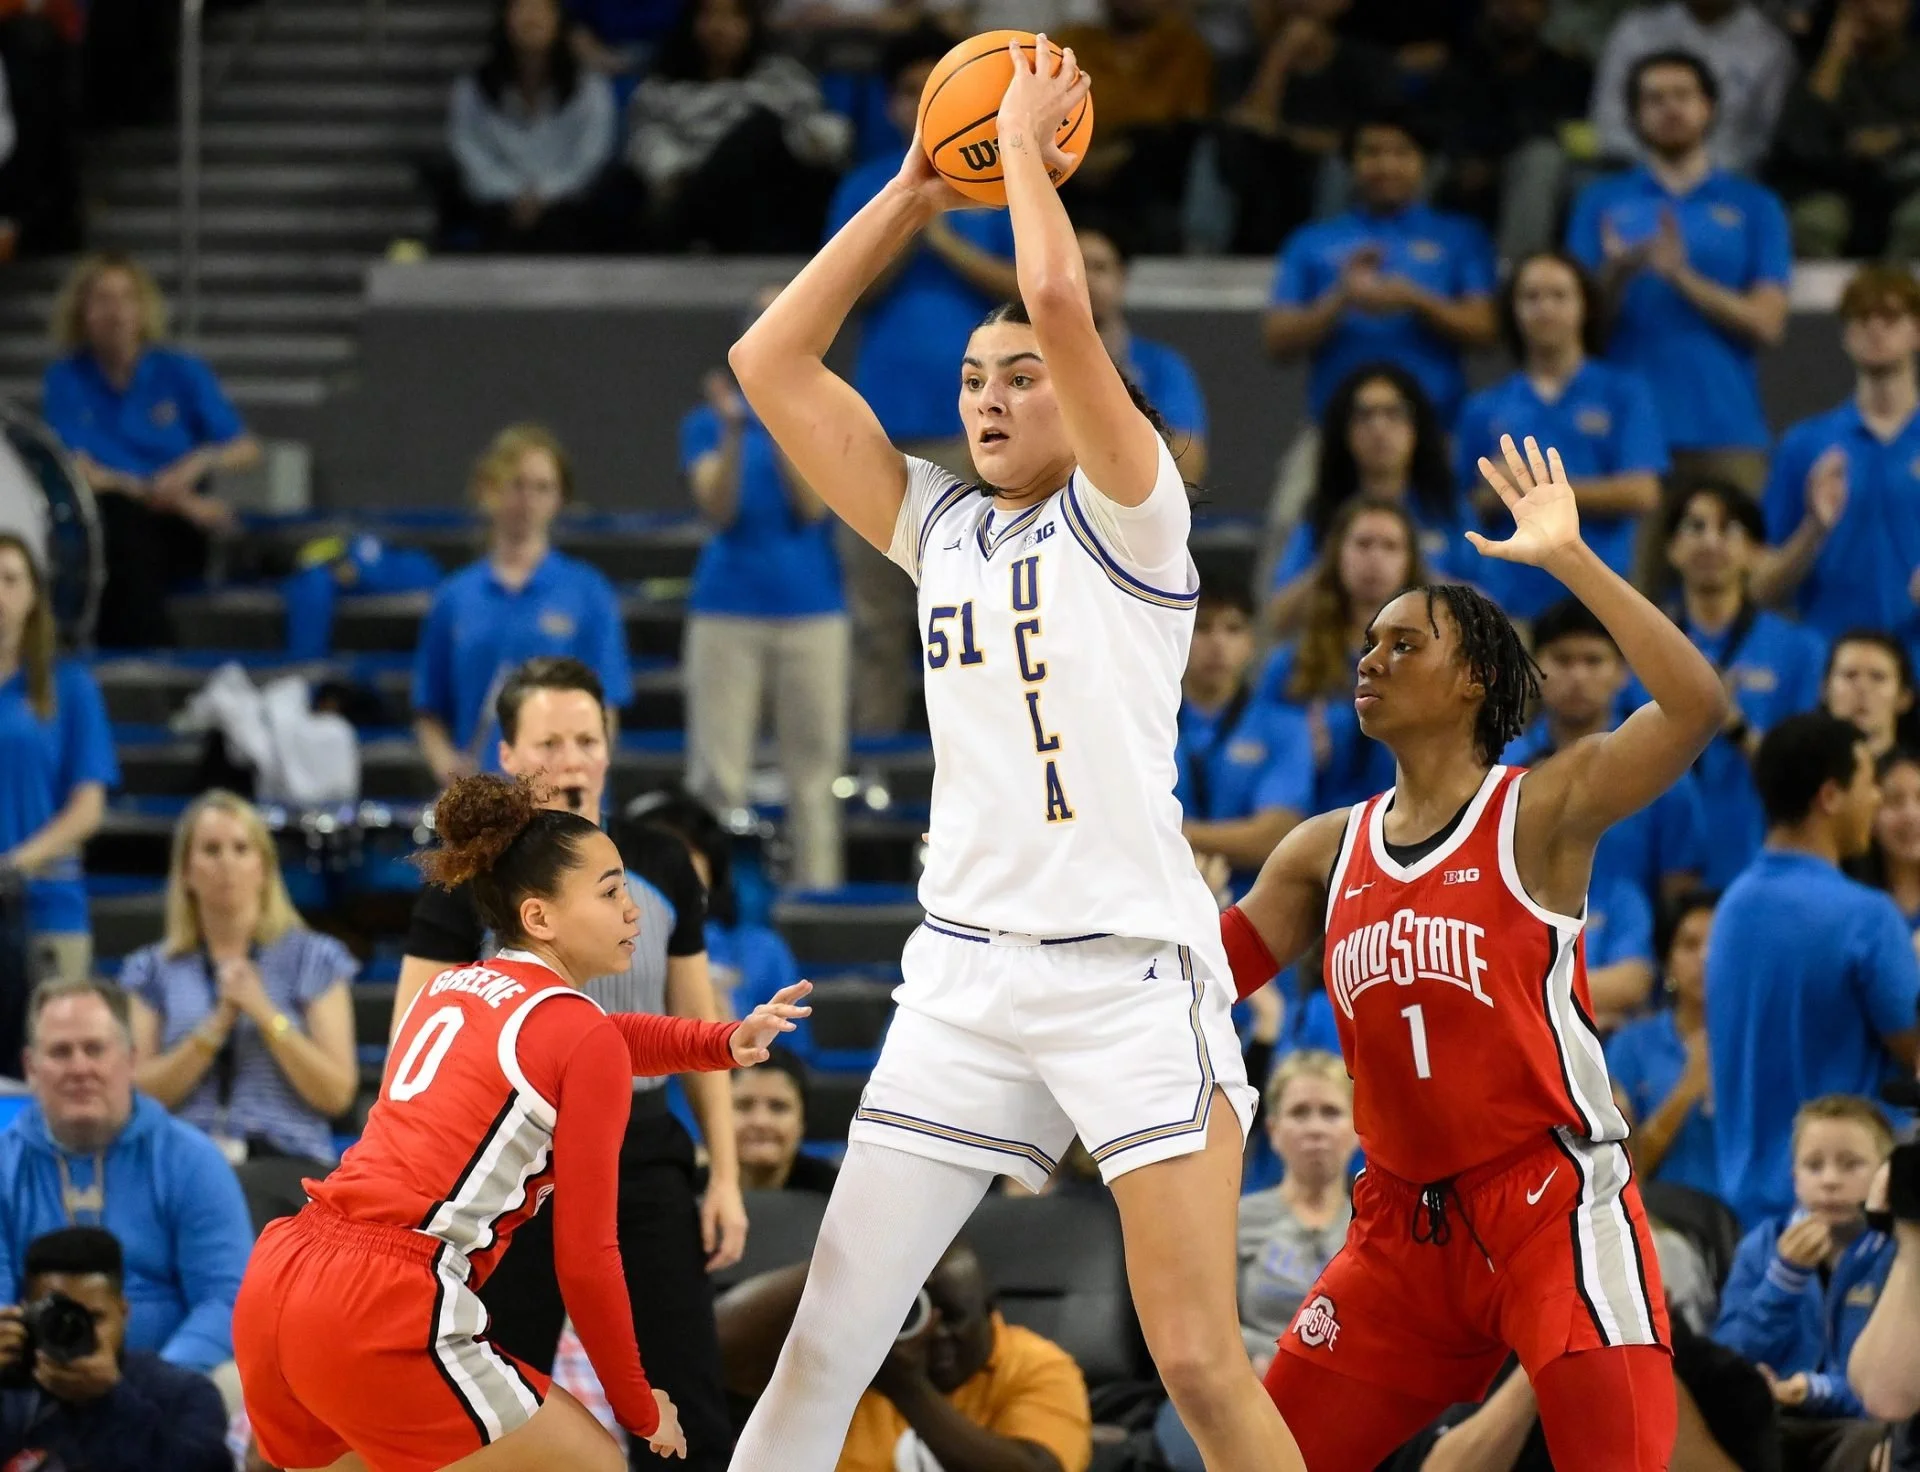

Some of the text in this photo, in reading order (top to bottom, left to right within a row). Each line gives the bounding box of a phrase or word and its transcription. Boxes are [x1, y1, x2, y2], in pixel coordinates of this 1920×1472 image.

[927, 599, 984, 669] 51
[428, 967, 526, 1008] GREENE
[389, 1006, 464, 1101] 0
[1401, 1004, 1432, 1079] 1
